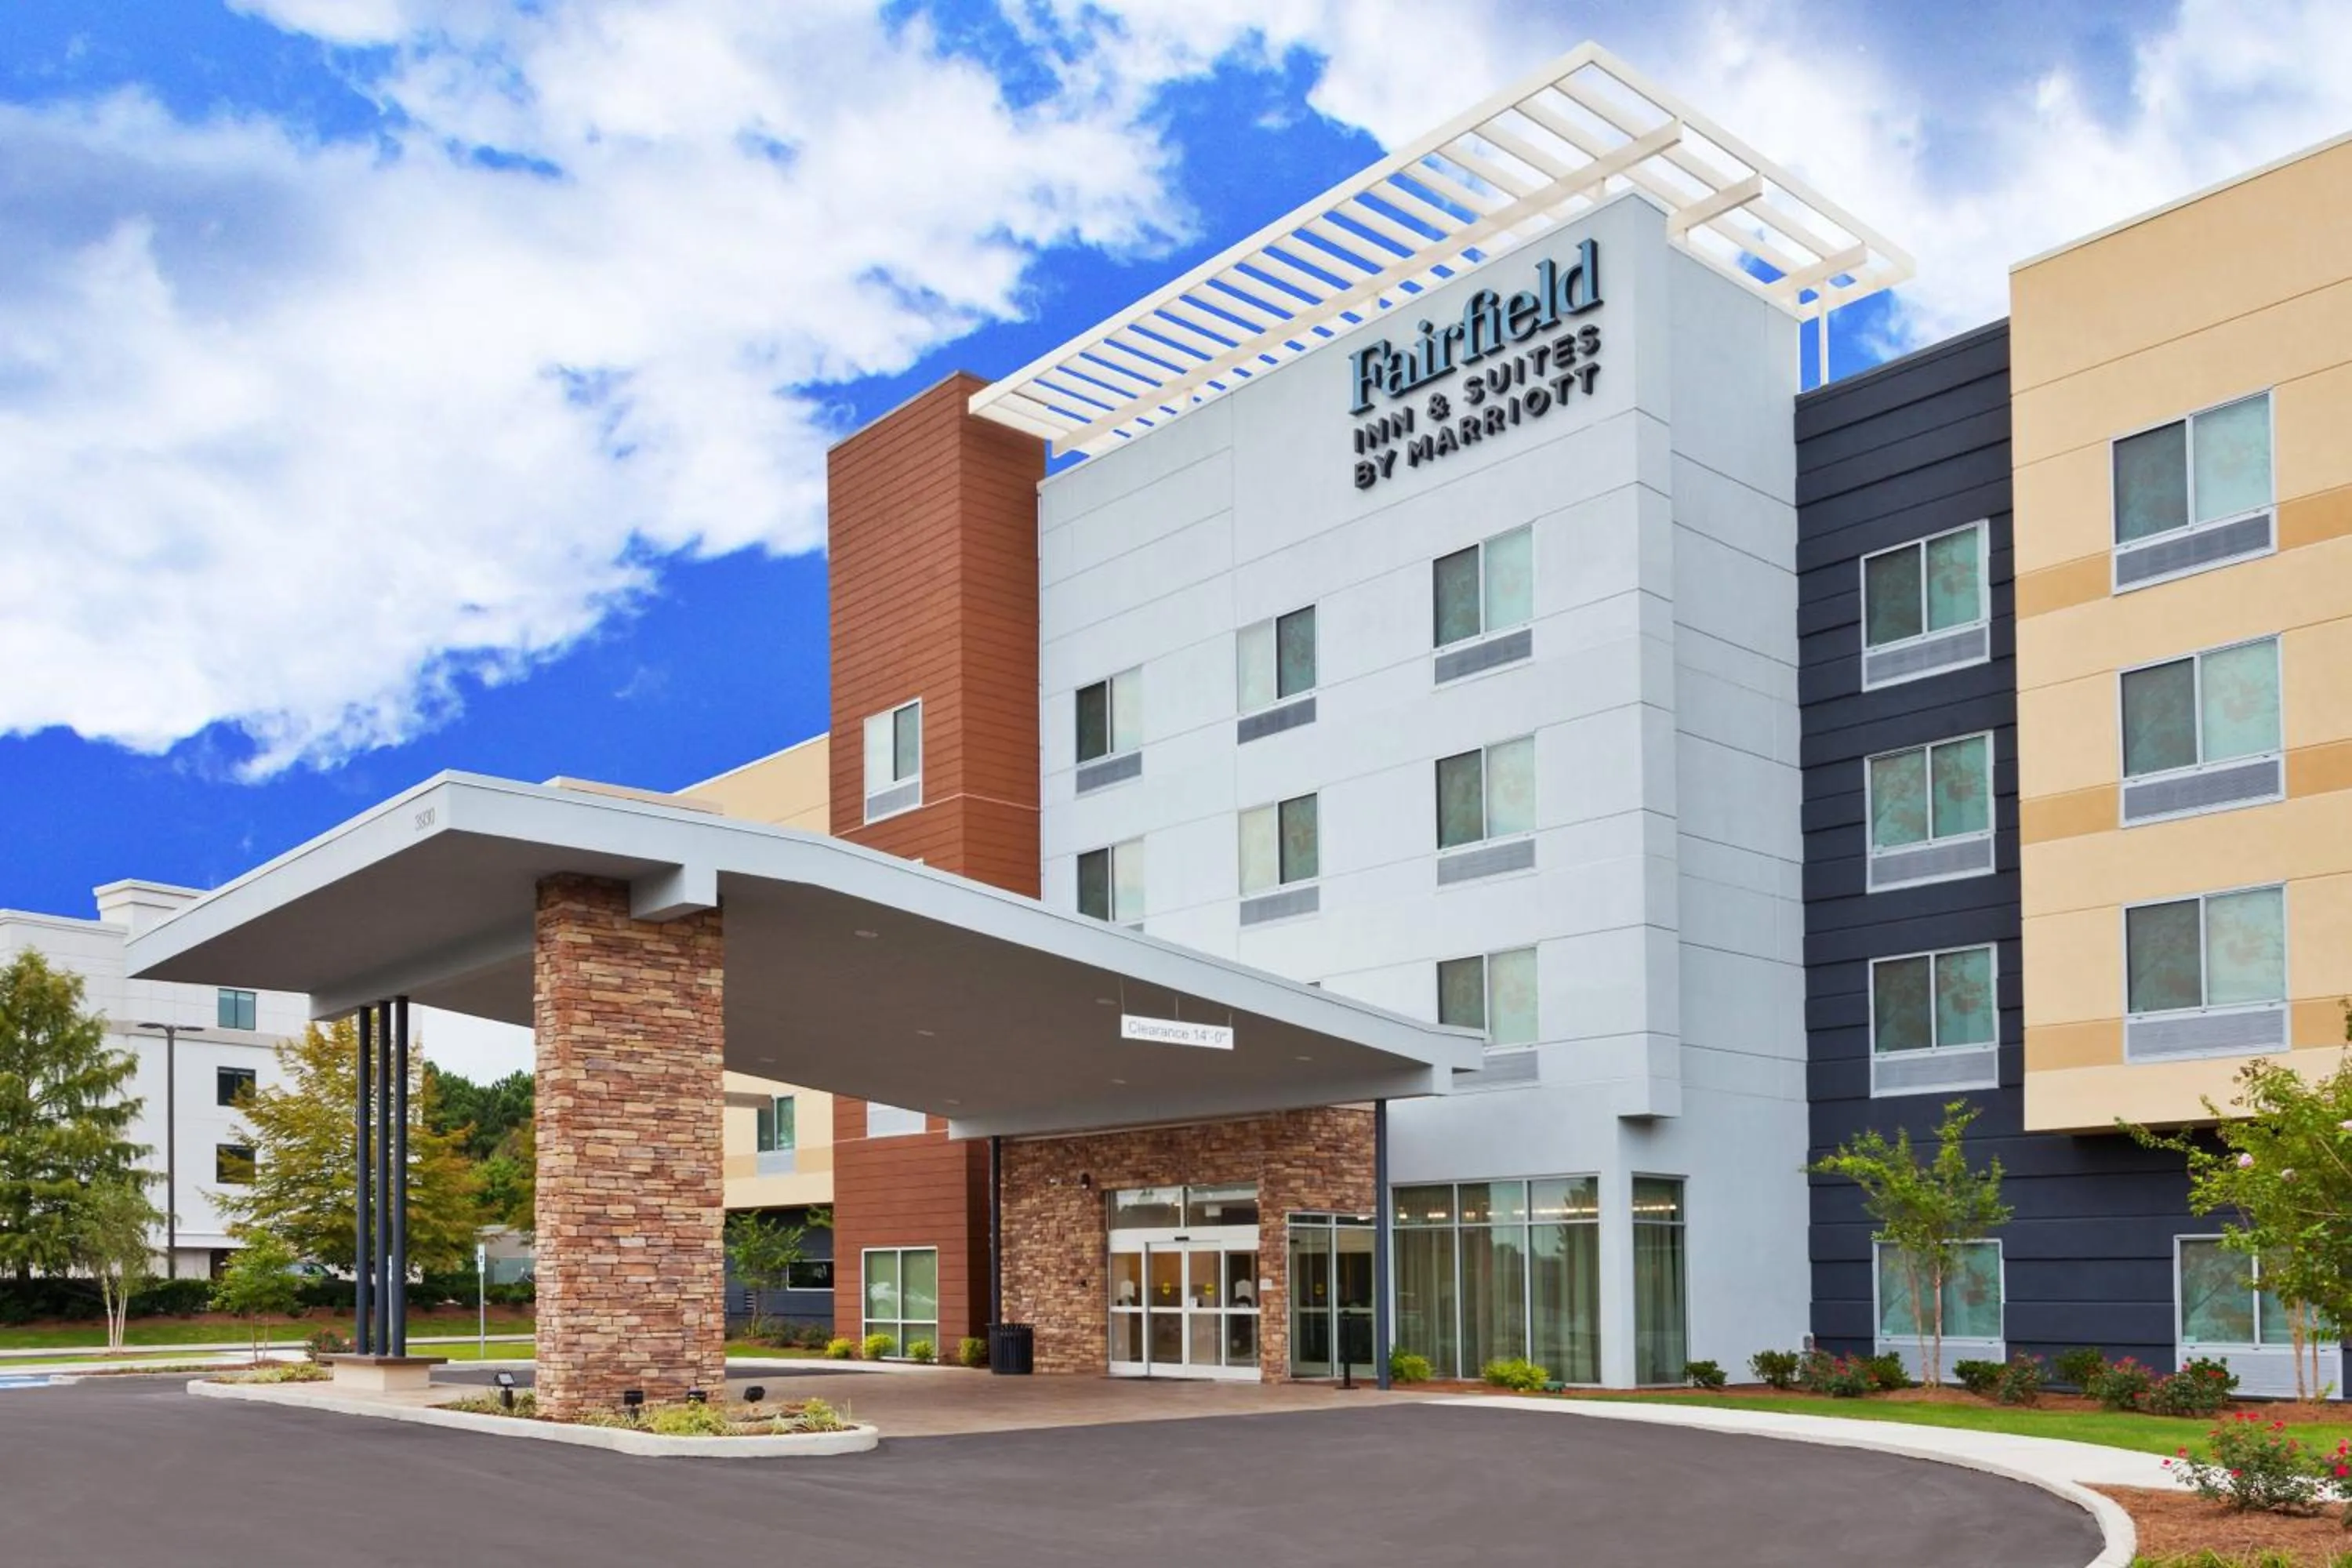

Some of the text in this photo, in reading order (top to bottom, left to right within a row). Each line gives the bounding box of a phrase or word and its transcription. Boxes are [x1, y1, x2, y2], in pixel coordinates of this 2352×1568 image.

[1348, 238, 1604, 416] Fairfield
[1354, 324, 1602, 455] INN & SUITES
[1354, 361, 1601, 490] BY MARRIOTT
[1127, 1021, 1189, 1040] Clearance
